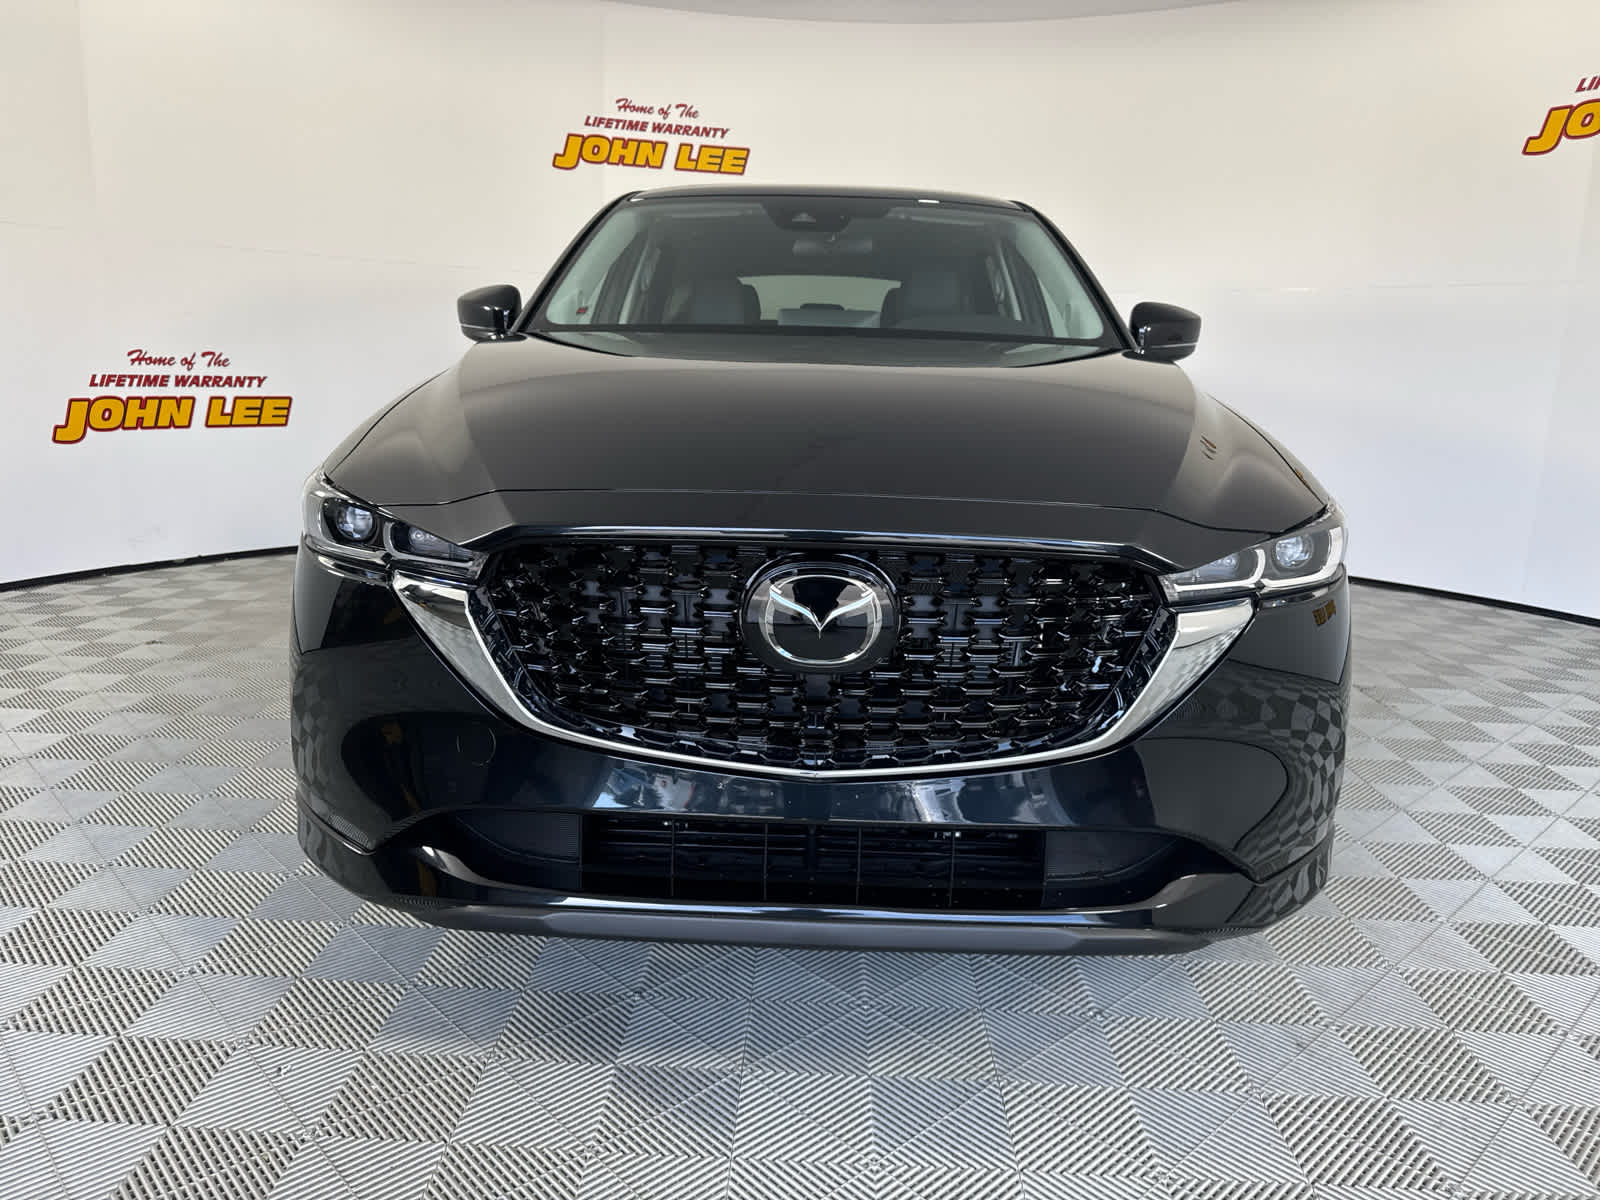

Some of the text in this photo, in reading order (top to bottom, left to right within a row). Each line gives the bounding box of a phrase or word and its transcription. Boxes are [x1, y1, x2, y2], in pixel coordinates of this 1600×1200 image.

[615, 98, 699, 119] Home of The
[584, 115, 729, 139] LIFETIME WARRANTY
[1522, 98, 1600, 156] JO
[552, 133, 750, 175] JOHN LEE
[127, 349, 231, 371] Home of The
[89, 374, 268, 388] LIFETIME WARRANTY
[52, 395, 292, 444] JOHN LEE
